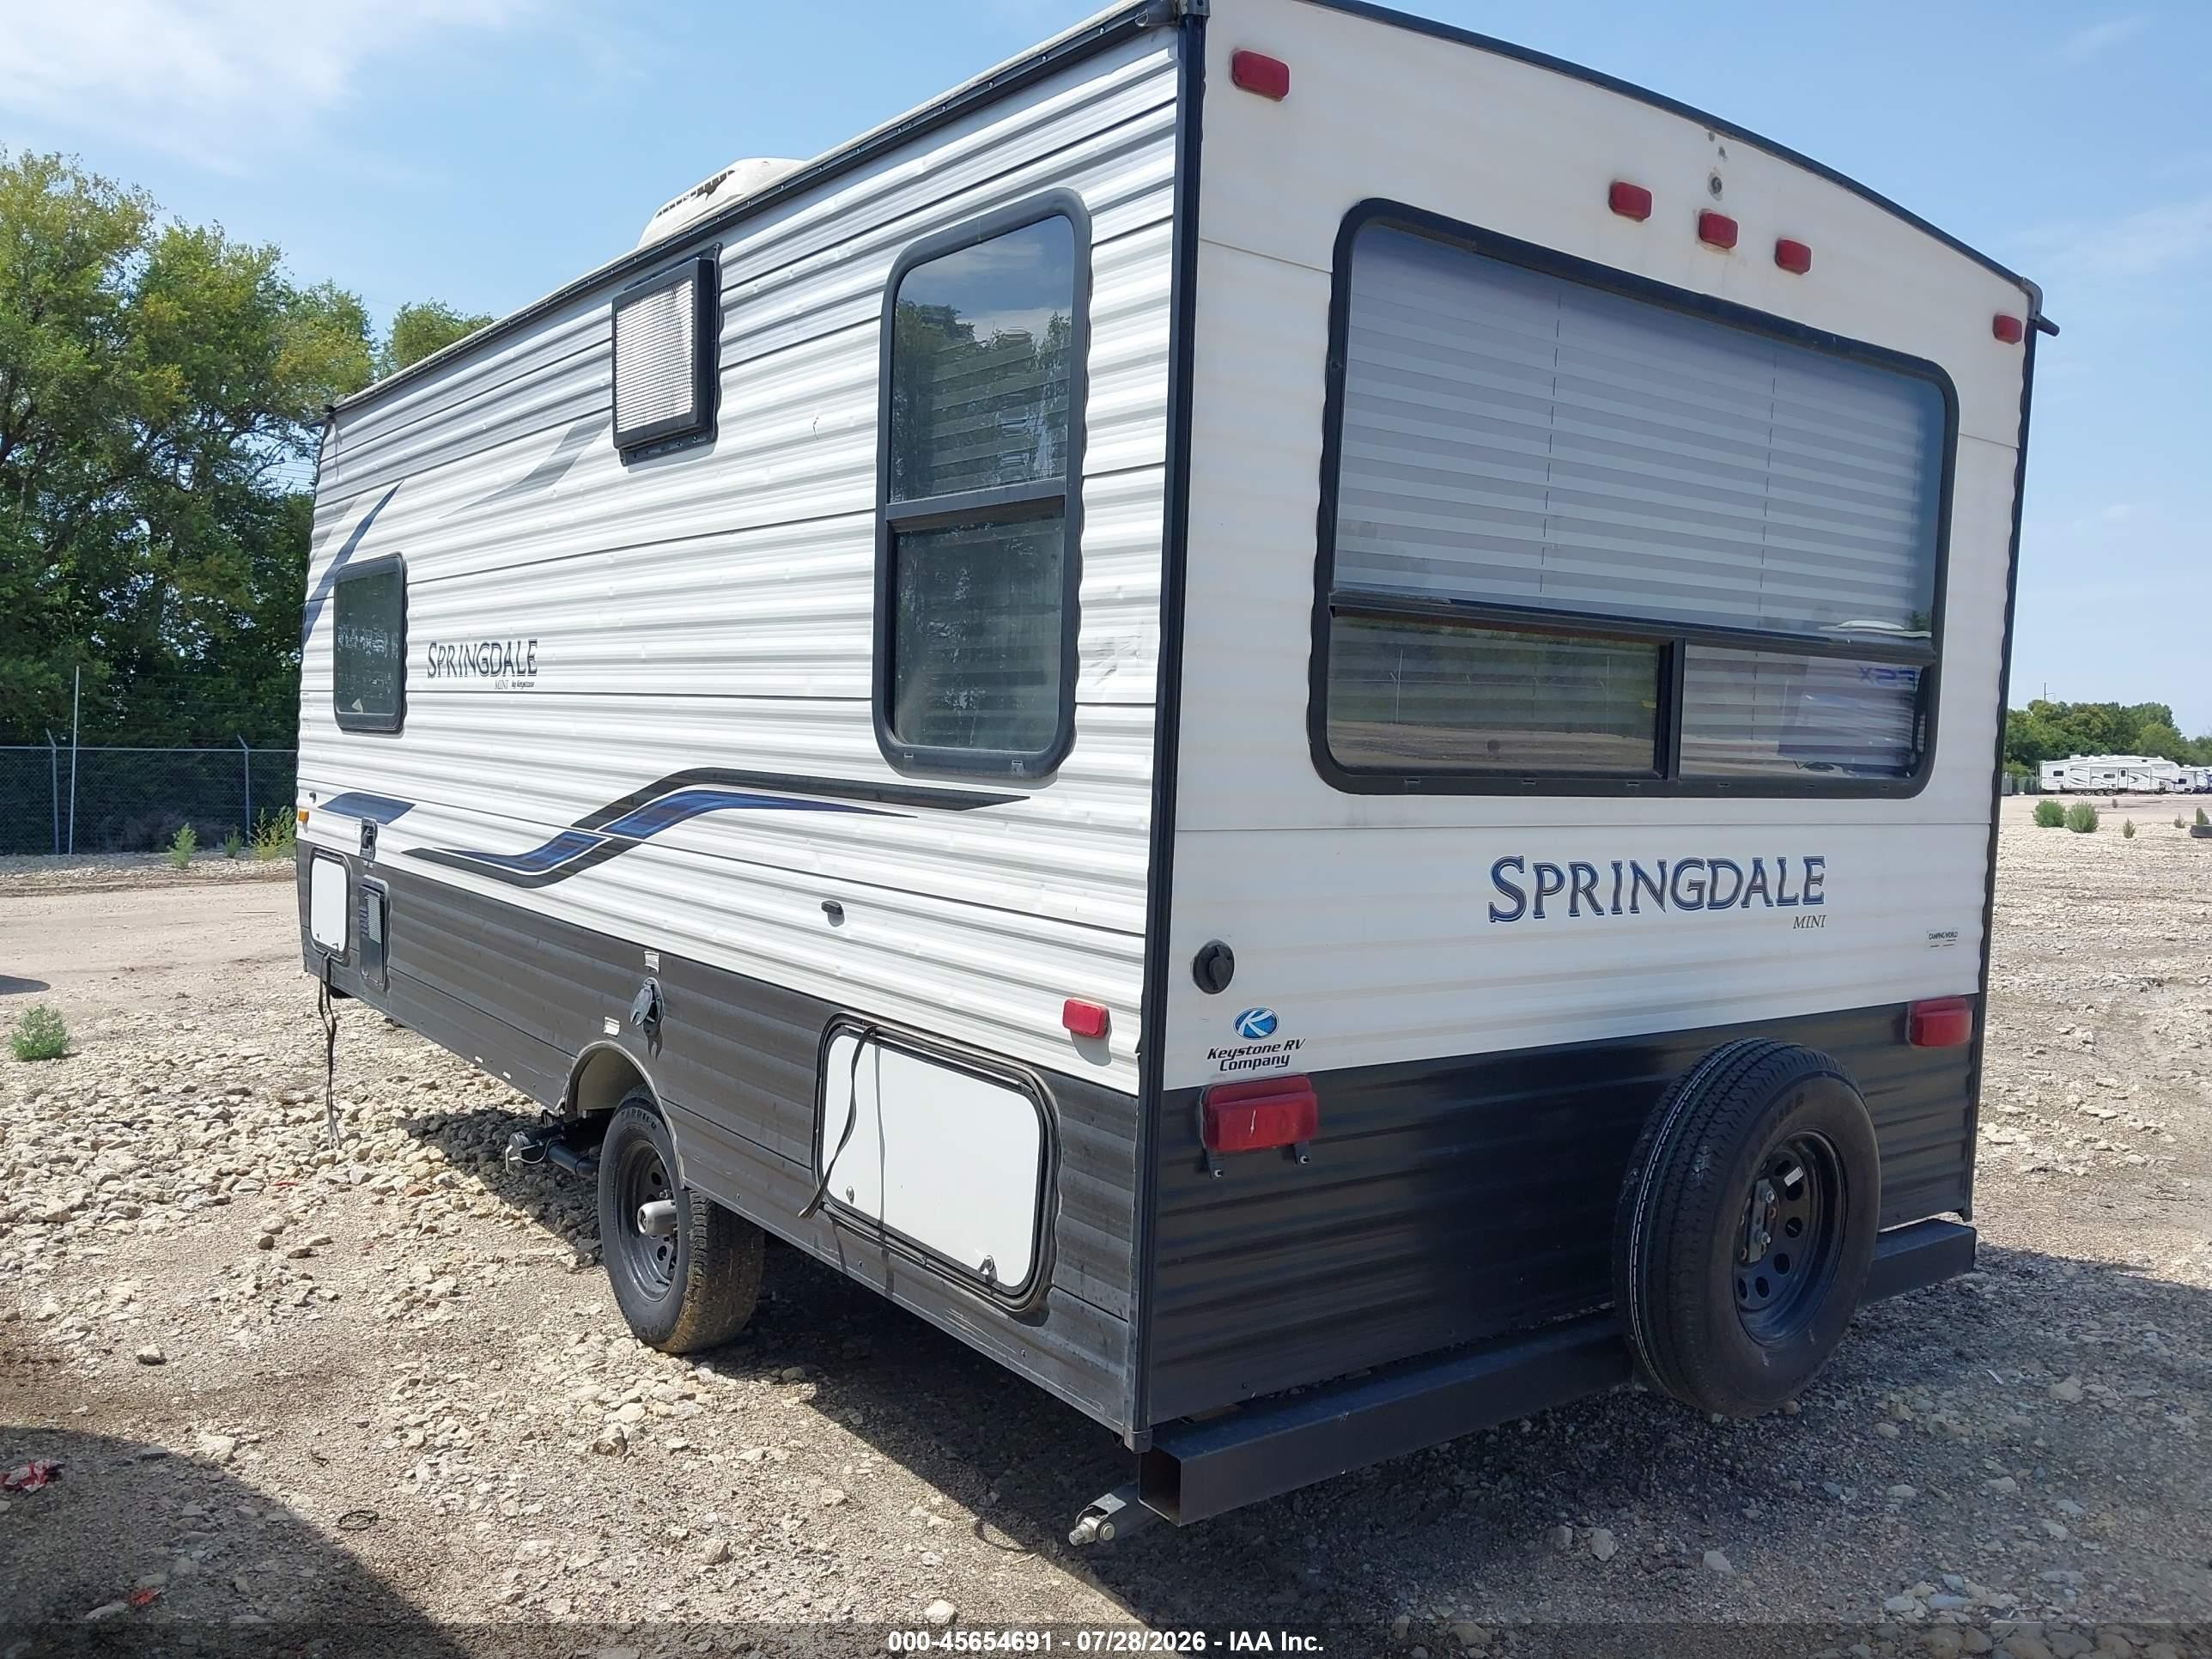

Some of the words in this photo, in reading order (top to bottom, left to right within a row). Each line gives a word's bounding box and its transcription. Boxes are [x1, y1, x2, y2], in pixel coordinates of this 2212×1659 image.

[428, 639, 538, 679] SPRINGDALE
[1488, 854, 1826, 923] SPRINGDALE
[1792, 915, 1827, 929] MINI
[1206, 1043, 1282, 1060] Keystone
[1284, 1037, 1306, 1052] RV
[1219, 1054, 1291, 1072] Company
